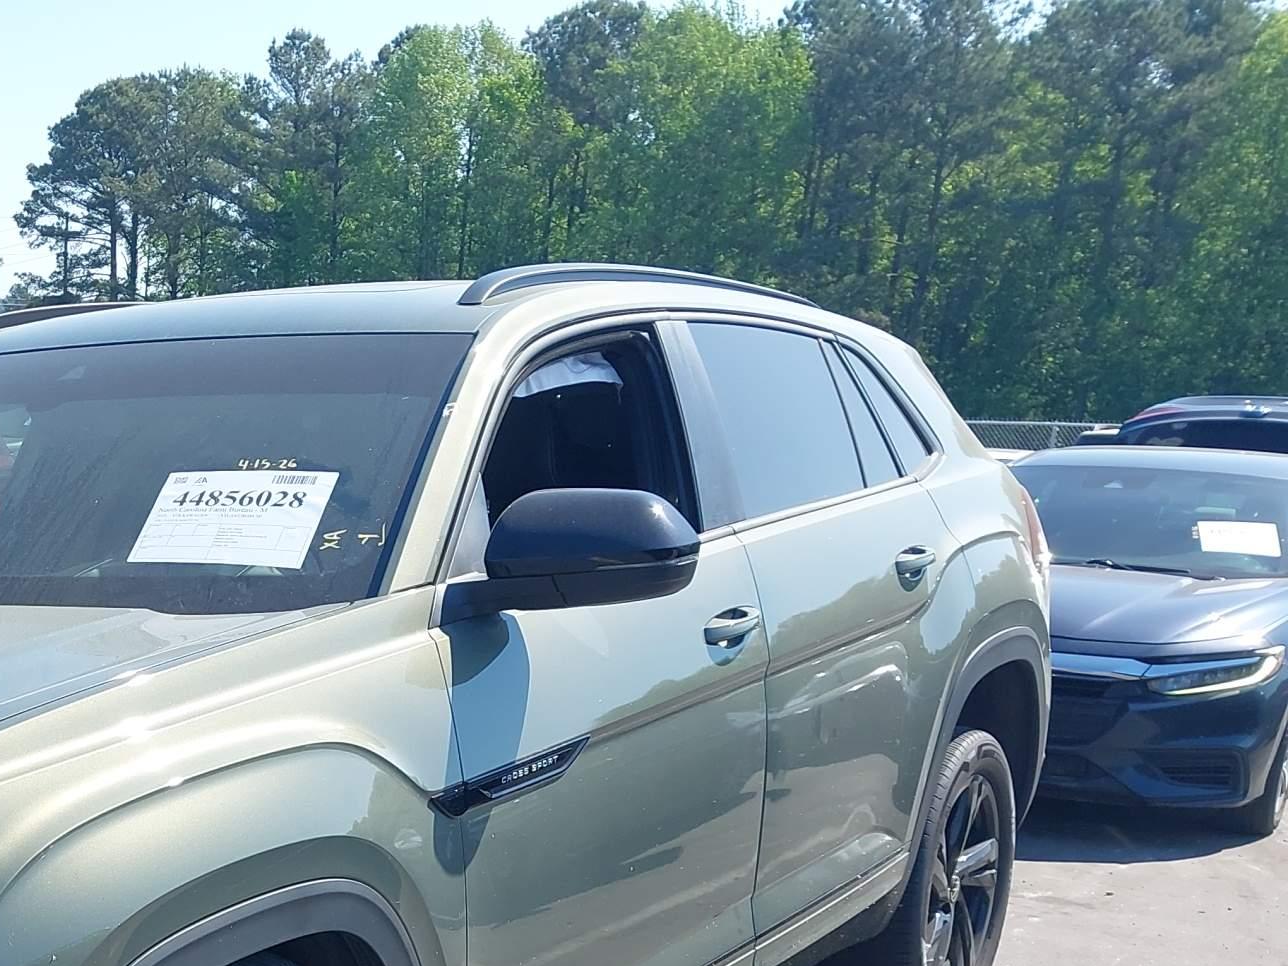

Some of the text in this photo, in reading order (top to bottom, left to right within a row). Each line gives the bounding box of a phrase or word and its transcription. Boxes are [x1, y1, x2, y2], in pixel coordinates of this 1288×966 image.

[172, 490, 308, 509] 44856028
[501, 755, 559, 784] CROSS SPORT
